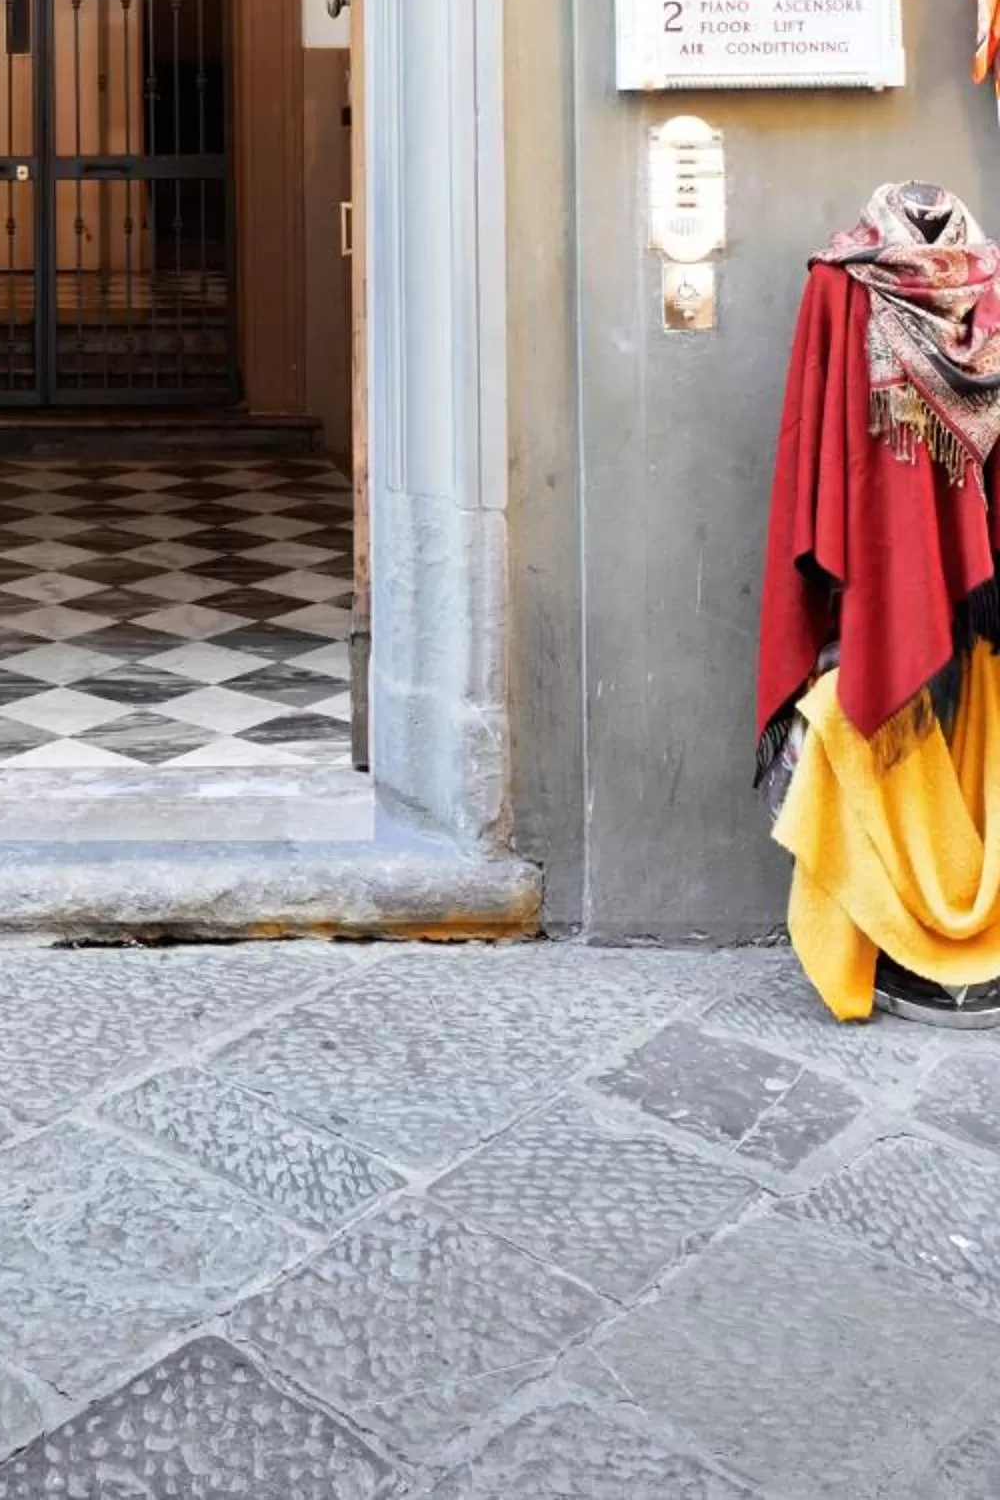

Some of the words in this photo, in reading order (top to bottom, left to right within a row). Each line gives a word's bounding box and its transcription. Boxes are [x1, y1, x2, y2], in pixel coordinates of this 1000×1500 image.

[700, 1, 750, 13] PIANO
[772, 0, 864, 13] ASCENSORE
[700, 21, 752, 34] FLOOR
[773, 20, 805, 34] LIFT
[679, 43, 705, 56] AIR
[725, 41, 850, 55] CONDITIONING
